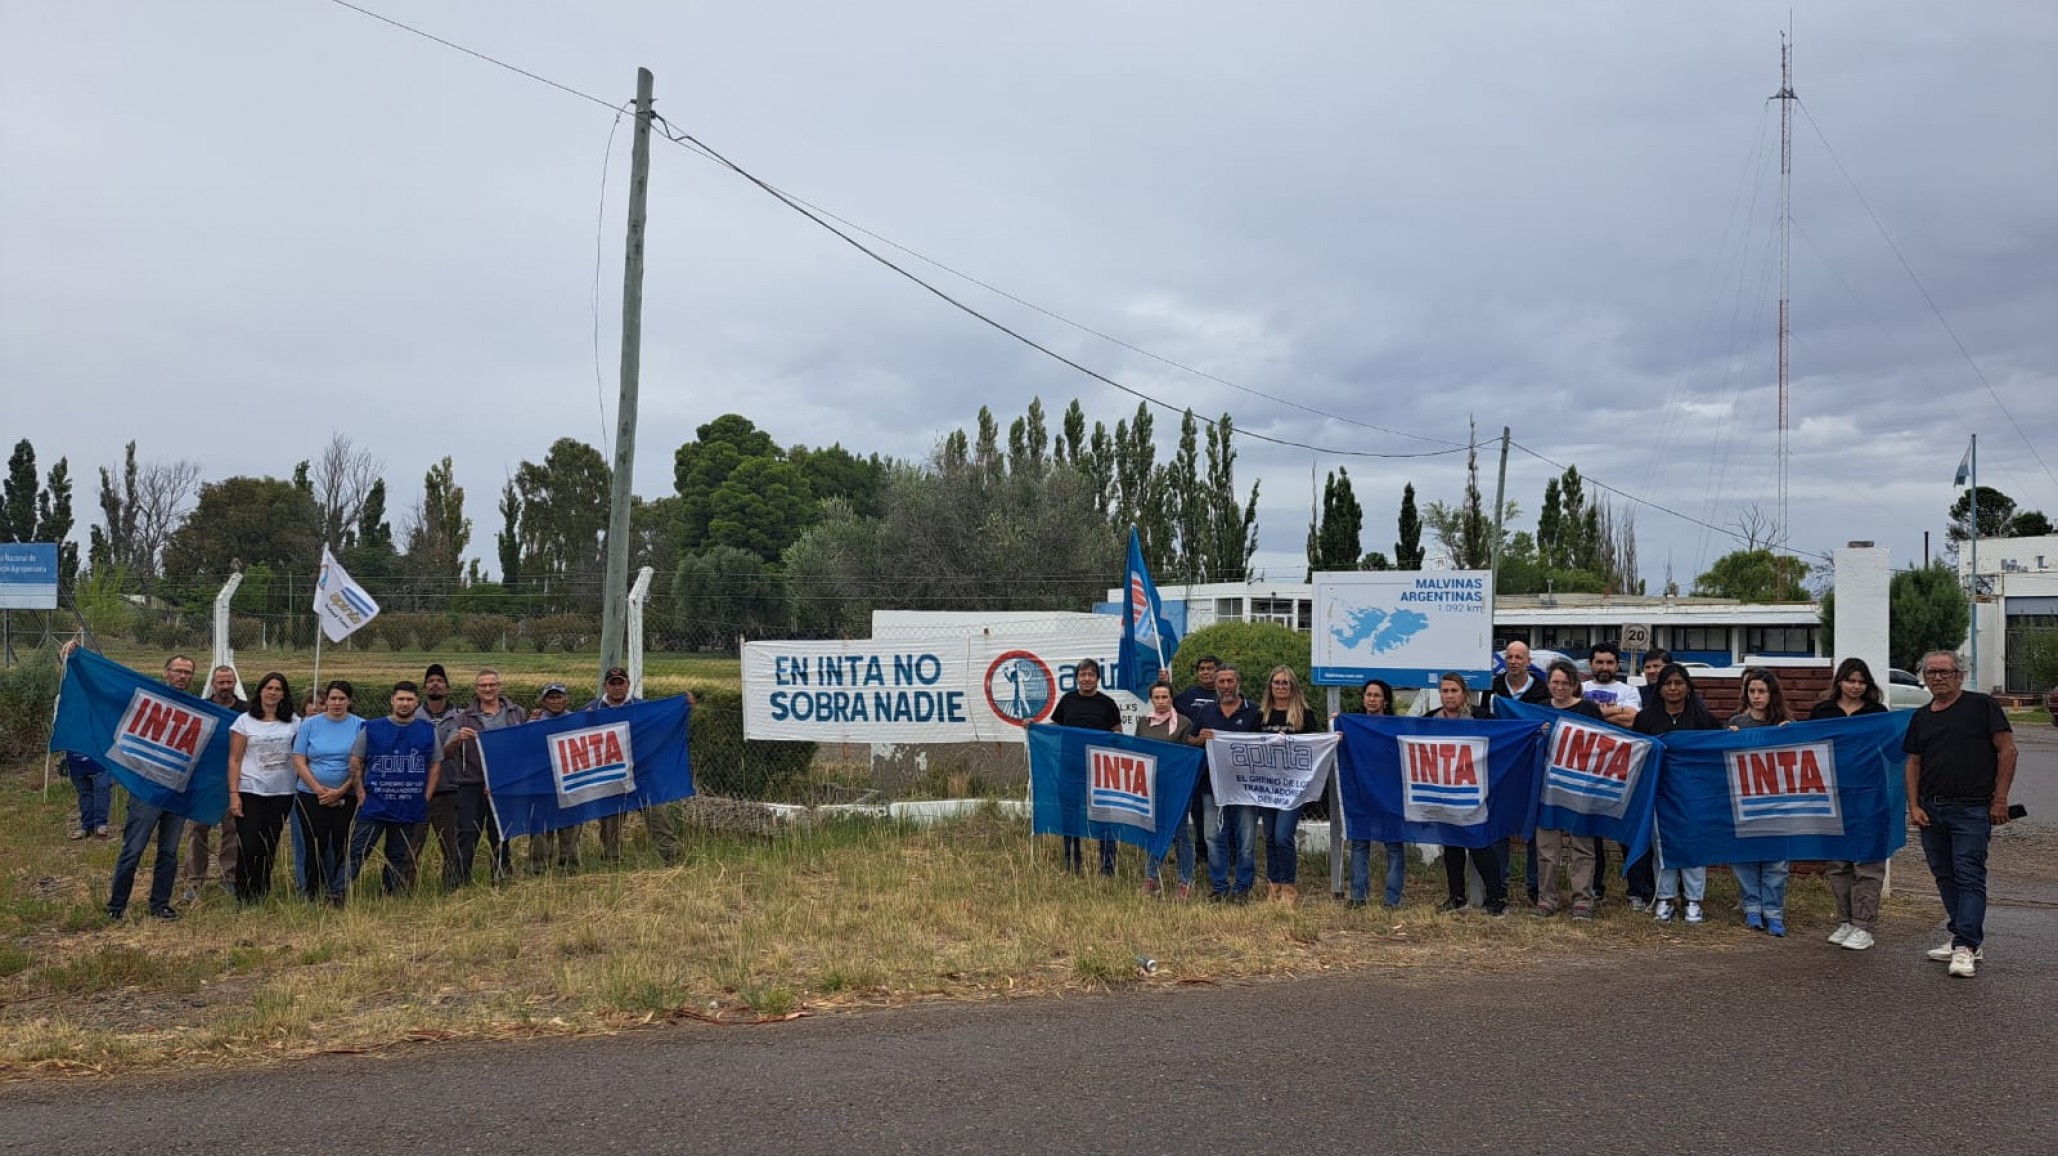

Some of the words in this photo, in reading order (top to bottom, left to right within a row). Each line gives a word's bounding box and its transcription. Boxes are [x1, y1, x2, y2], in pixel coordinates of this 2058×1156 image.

[1400, 591, 1483, 602] ARGENTINAS
[1415, 577, 1483, 589] MALVINAS
[1628, 630, 1645, 641] 20
[775, 655, 809, 686] EN
[817, 655, 885, 686] INTA
[894, 653, 942, 686] NO
[127, 698, 203, 756] INTA
[769, 690, 869, 722] SOBRA
[874, 690, 967, 722] NADIE
[557, 730, 625, 775] INTA
[1408, 743, 1477, 785] INTA
[1554, 726, 1632, 781] INTA
[1736, 750, 1827, 796] INTA
[1094, 752, 1149, 798] INTA
